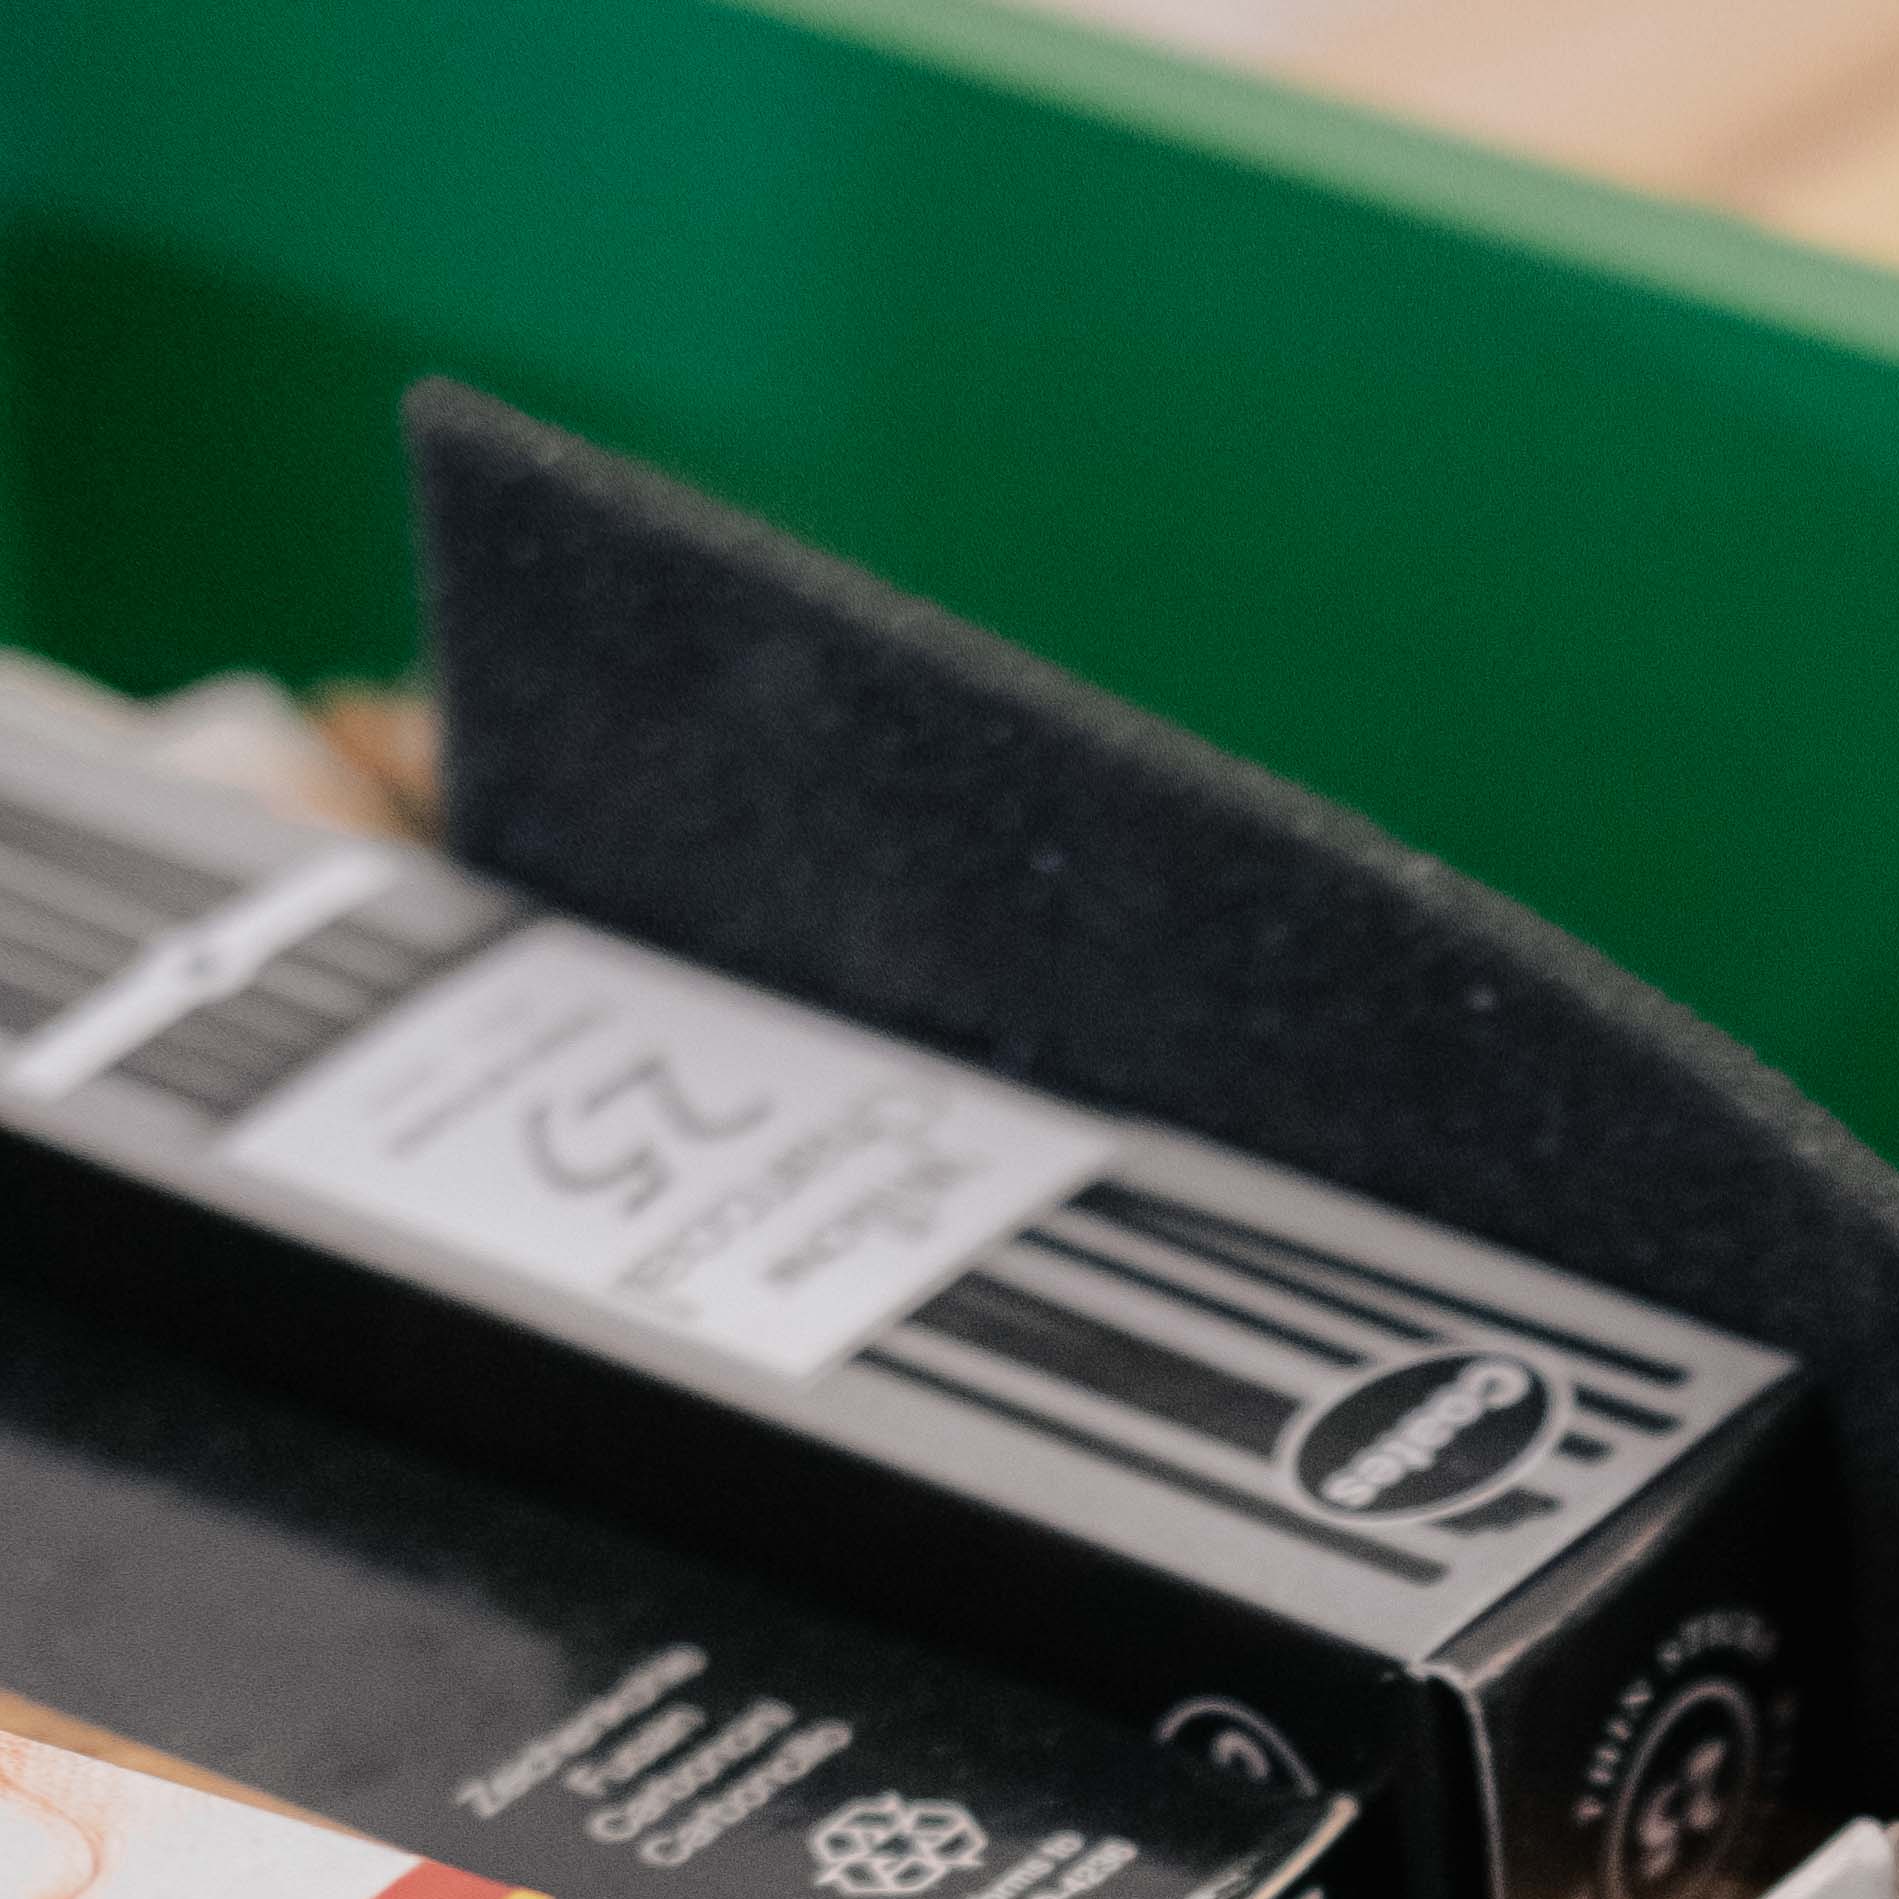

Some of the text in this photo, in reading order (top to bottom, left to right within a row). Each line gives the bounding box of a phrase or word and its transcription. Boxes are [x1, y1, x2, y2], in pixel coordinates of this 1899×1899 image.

[520, 1052, 776, 1220] 25
[1319, 1358, 1531, 1510] Coates
[1040, 1829, 1085, 1860] to
